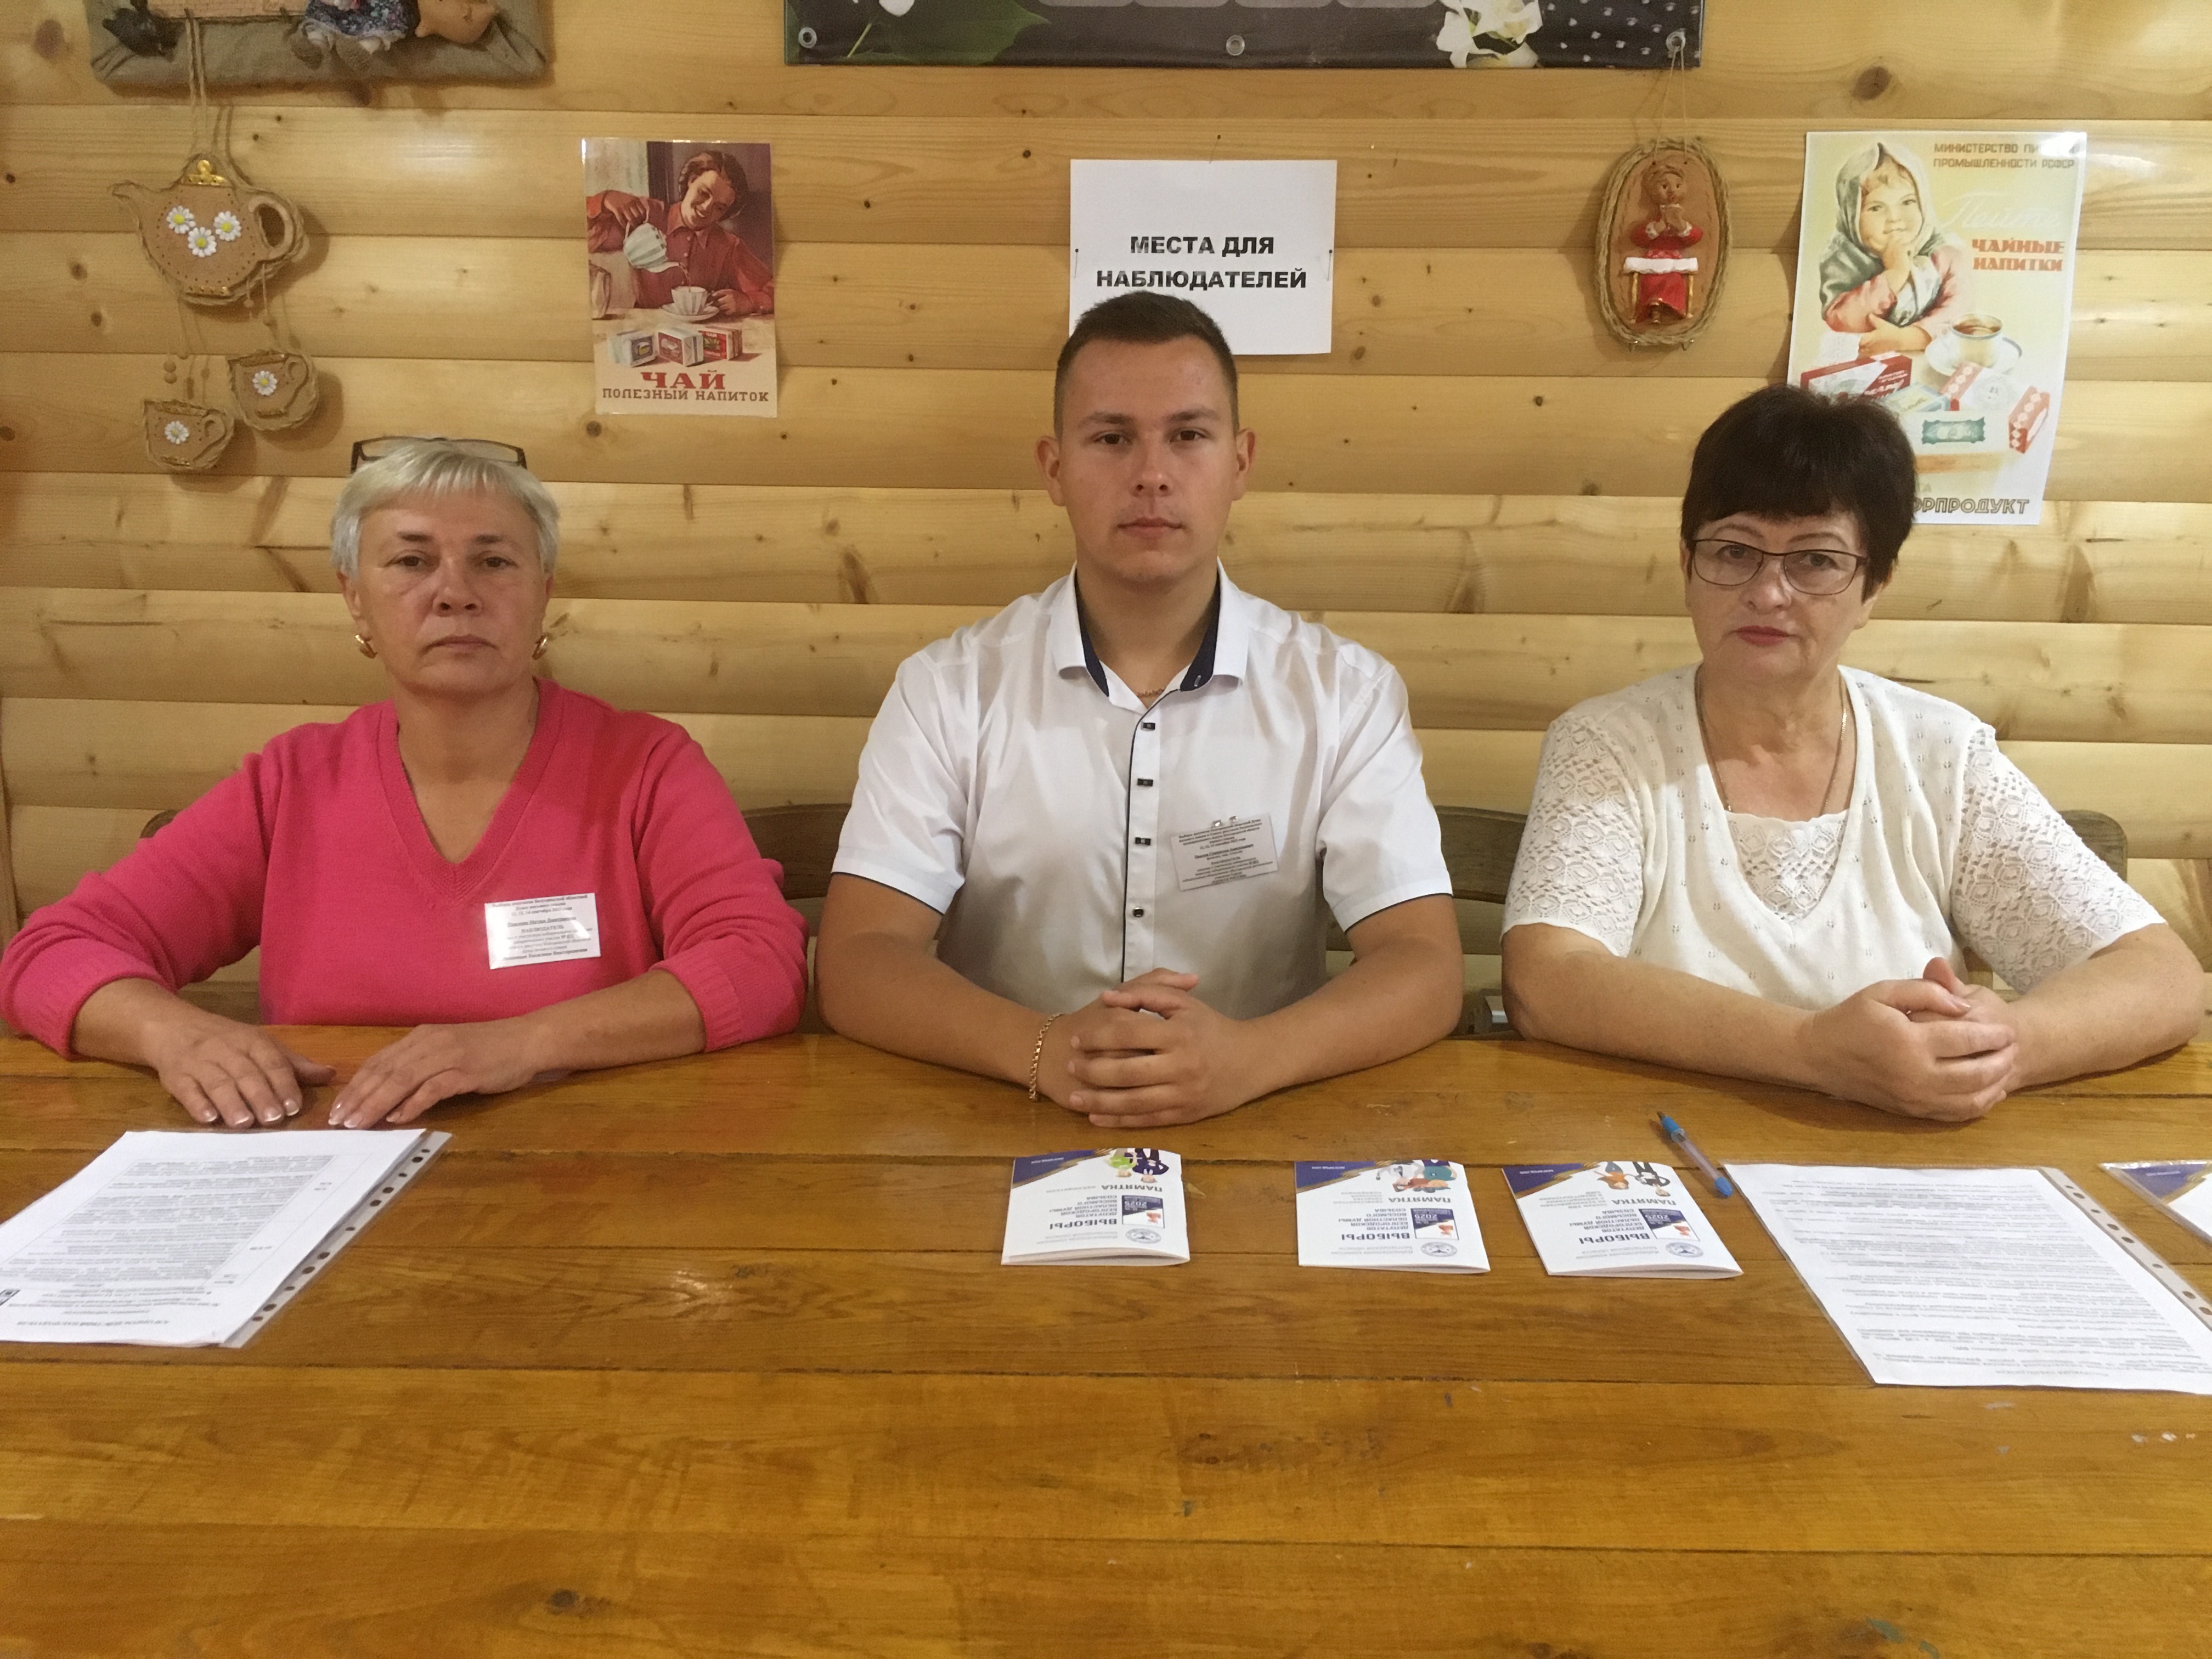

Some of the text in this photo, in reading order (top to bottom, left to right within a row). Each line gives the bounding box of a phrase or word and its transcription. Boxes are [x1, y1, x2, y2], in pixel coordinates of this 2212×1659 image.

[1934, 144, 2018, 154] МИНИСТЕРСТВО
[1933, 158, 2075, 168] ПРОМЫШЛЕННОСТИ РСФСР
[1130, 236, 1274, 257] МЕСТА ДЛЯ
[1971, 238, 2065, 254] ЧАЙНЫЕ
[1972, 258, 2063, 272] НАПИТКИ
[1097, 268, 1307, 291] НАБЛЮДАТЕЛЕЙ
[640, 370, 726, 390] ЧАЙ
[602, 388, 770, 403] ПОЛЕЗНЫЙ НАПИТОК
[1049, 1218, 1117, 1229] ВЫБОРЫ
[1579, 1233, 1650, 1244] ВЫБОРЫ
